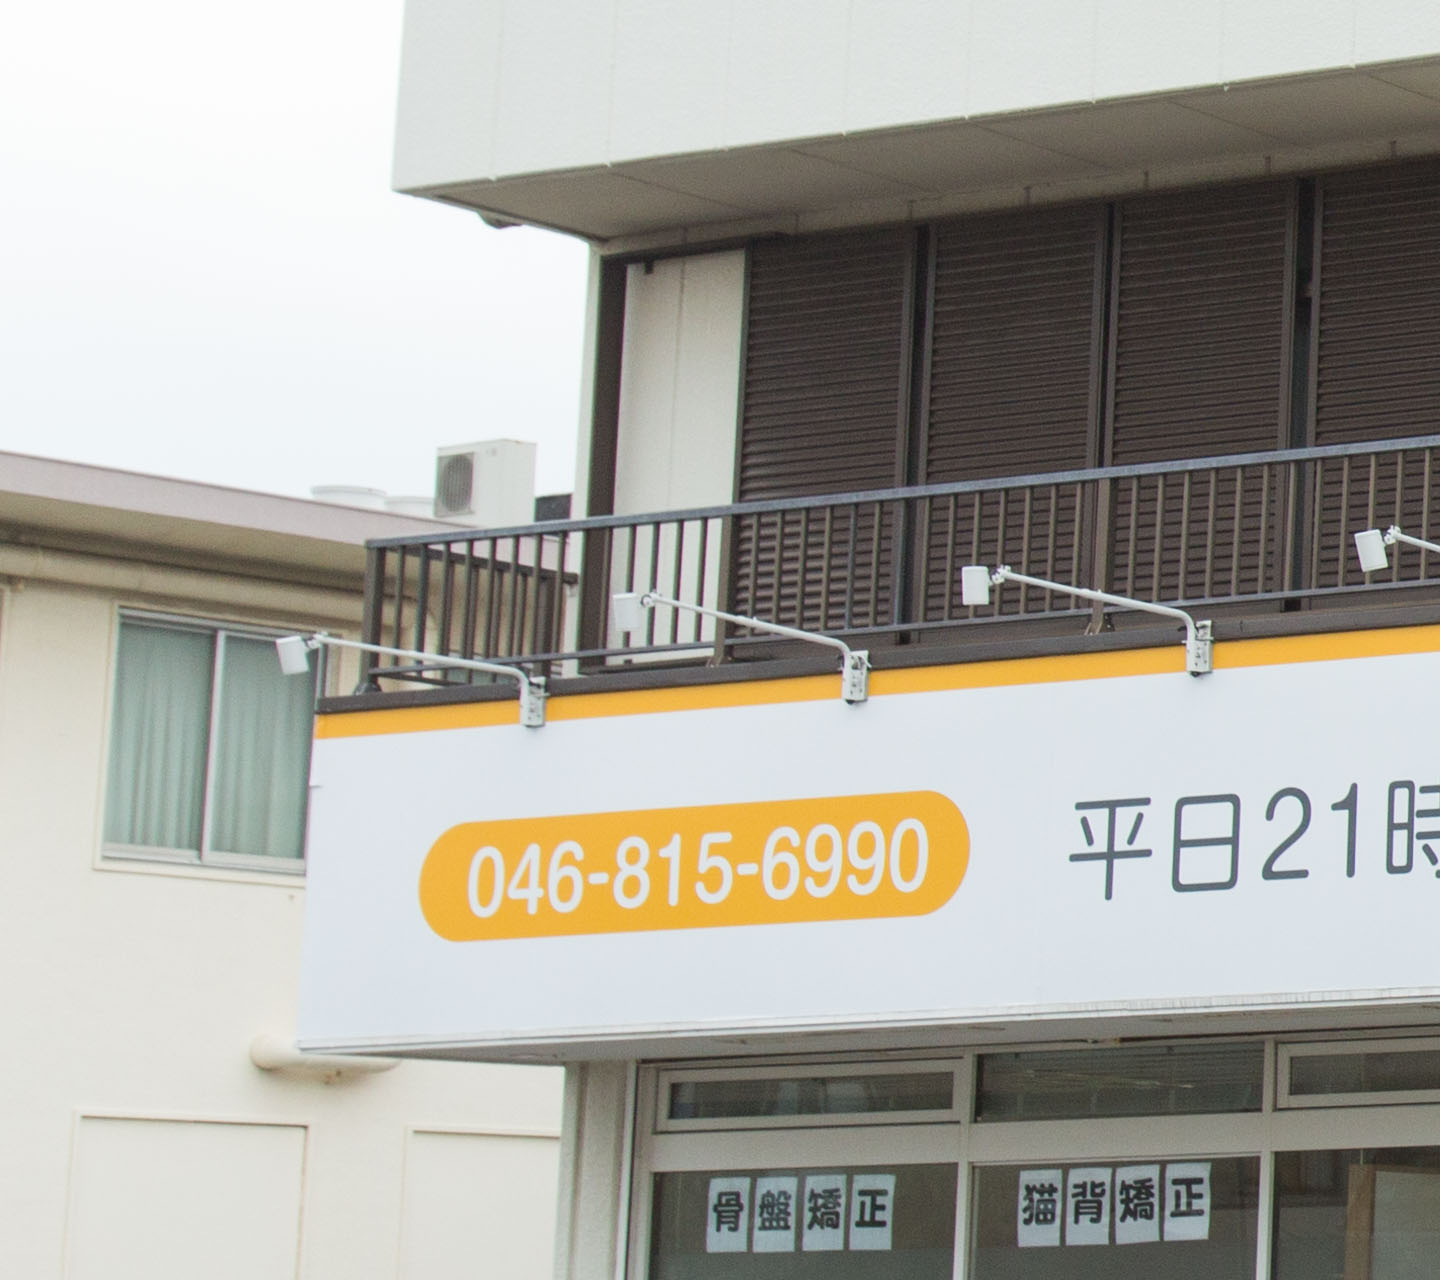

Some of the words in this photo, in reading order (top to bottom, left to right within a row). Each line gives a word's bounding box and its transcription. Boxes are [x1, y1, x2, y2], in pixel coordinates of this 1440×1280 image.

[468, 818, 929, 918] 046-815-6990
[713, 1190, 888, 1233] 骨盤矯正
[1022, 1176, 1206, 1226] 猫背矯正
